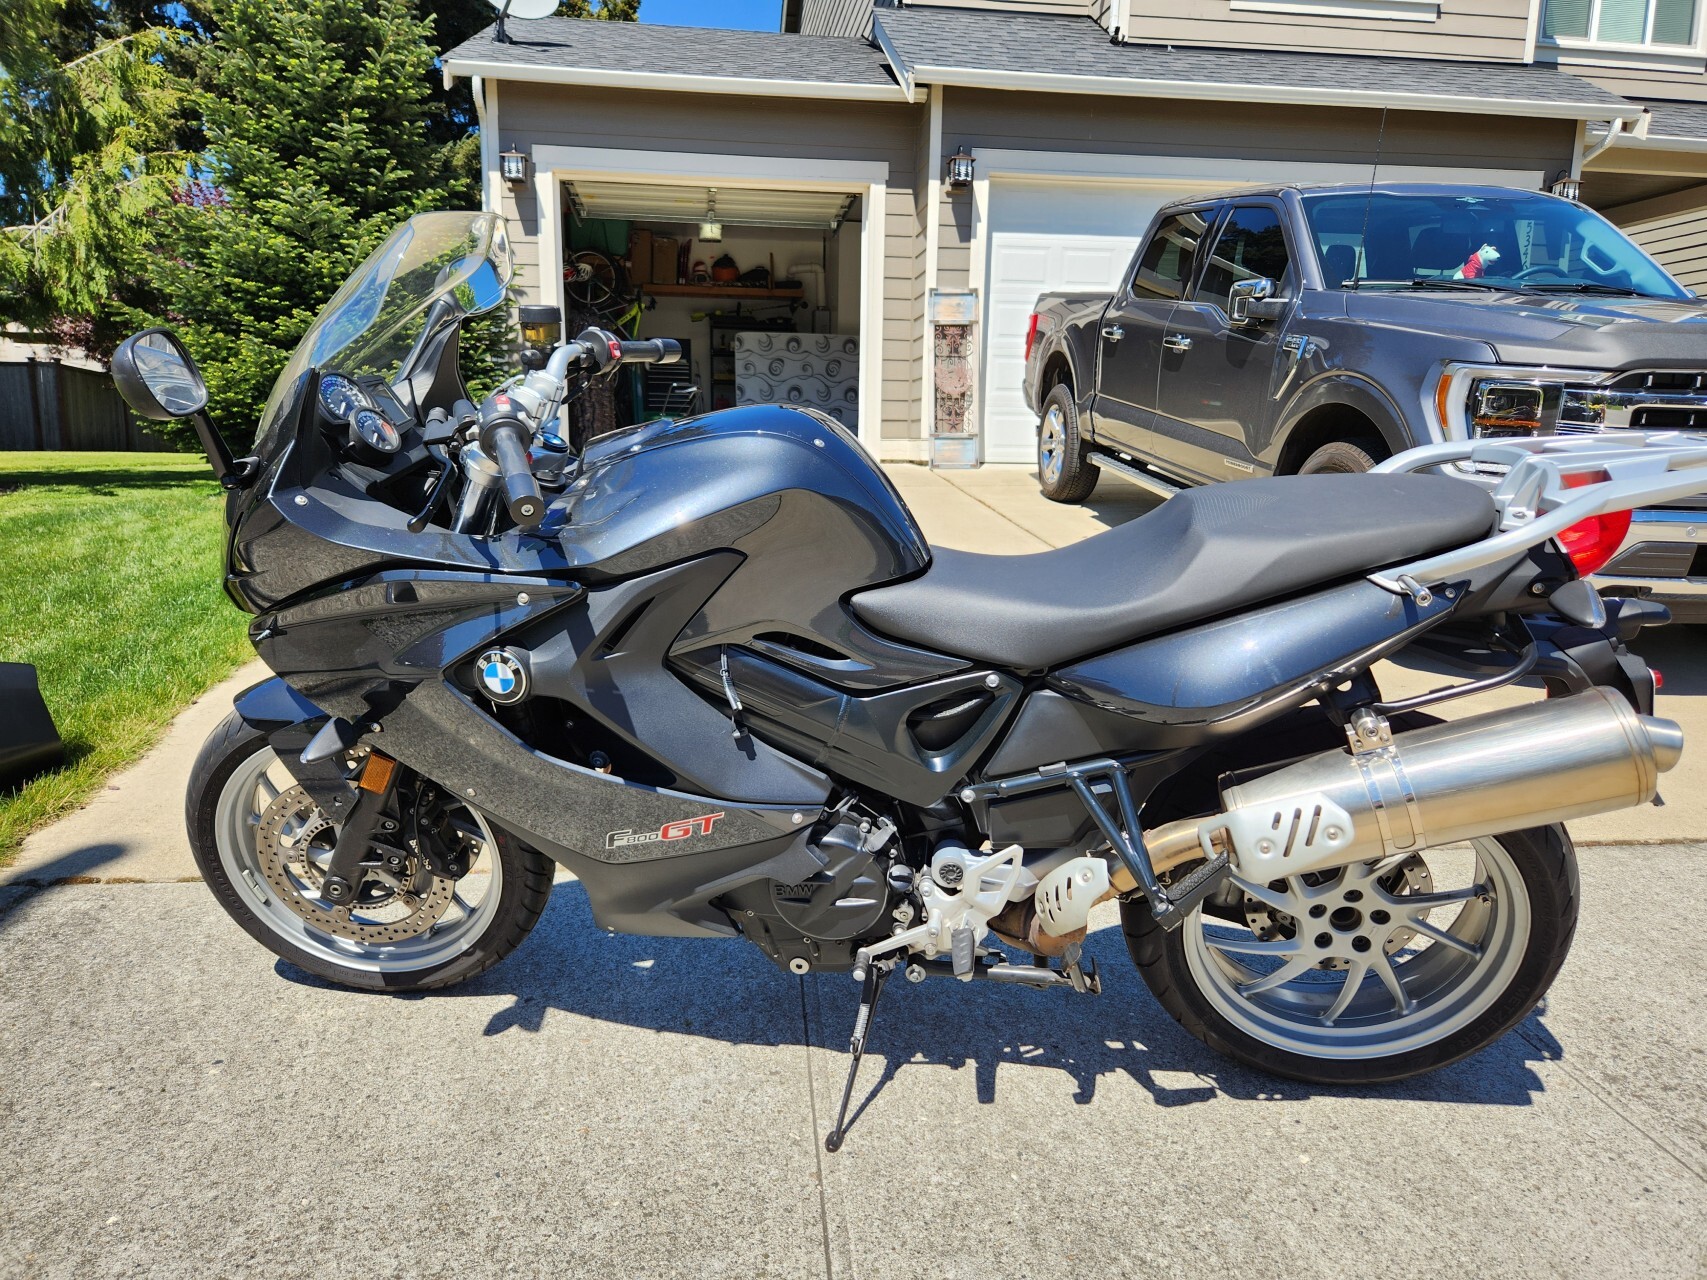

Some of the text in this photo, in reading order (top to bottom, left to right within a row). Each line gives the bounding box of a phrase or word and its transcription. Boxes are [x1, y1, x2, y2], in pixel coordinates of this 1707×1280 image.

[477, 653, 519, 672] BMW
[774, 884, 815, 897] BMW
[1459, 984, 1531, 1049] METZELER
